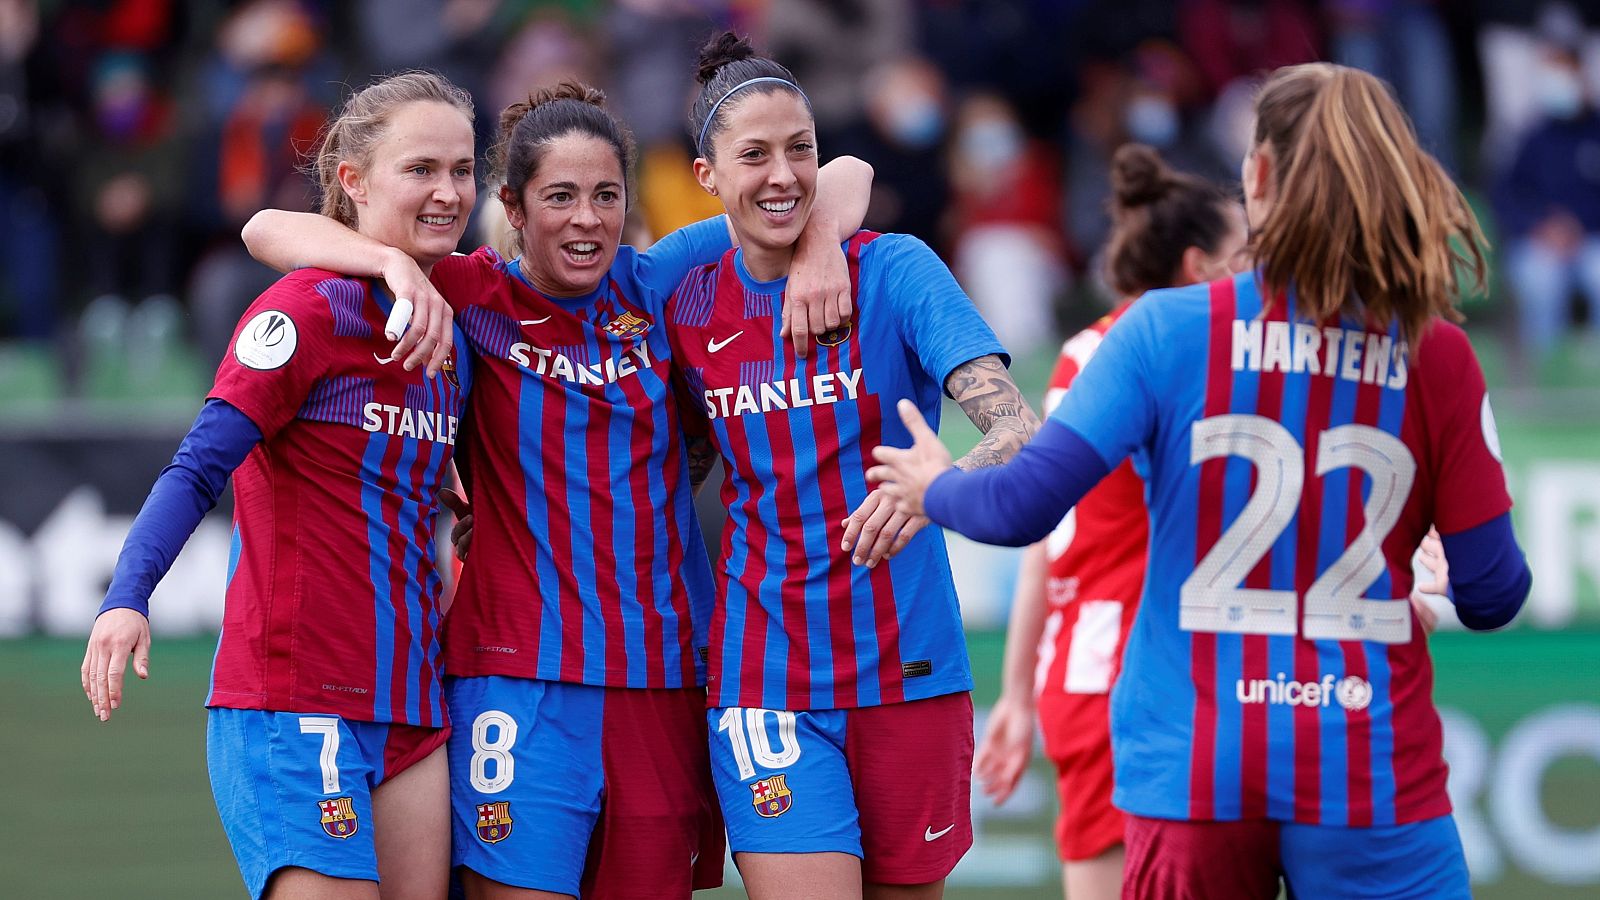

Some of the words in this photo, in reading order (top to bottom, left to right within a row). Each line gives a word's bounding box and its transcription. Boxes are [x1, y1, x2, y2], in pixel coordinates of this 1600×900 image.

[508, 340, 651, 386] STANLEY
[1231, 319, 1409, 390] MARTENS
[362, 402, 459, 446] STANLE
[704, 368, 863, 420] STANLEY
[1179, 414, 1417, 644] 22
[1236, 672, 1336, 708] unicef
[298, 716, 341, 794] 7
[469, 710, 518, 794] 8
[718, 707, 801, 781] 10
